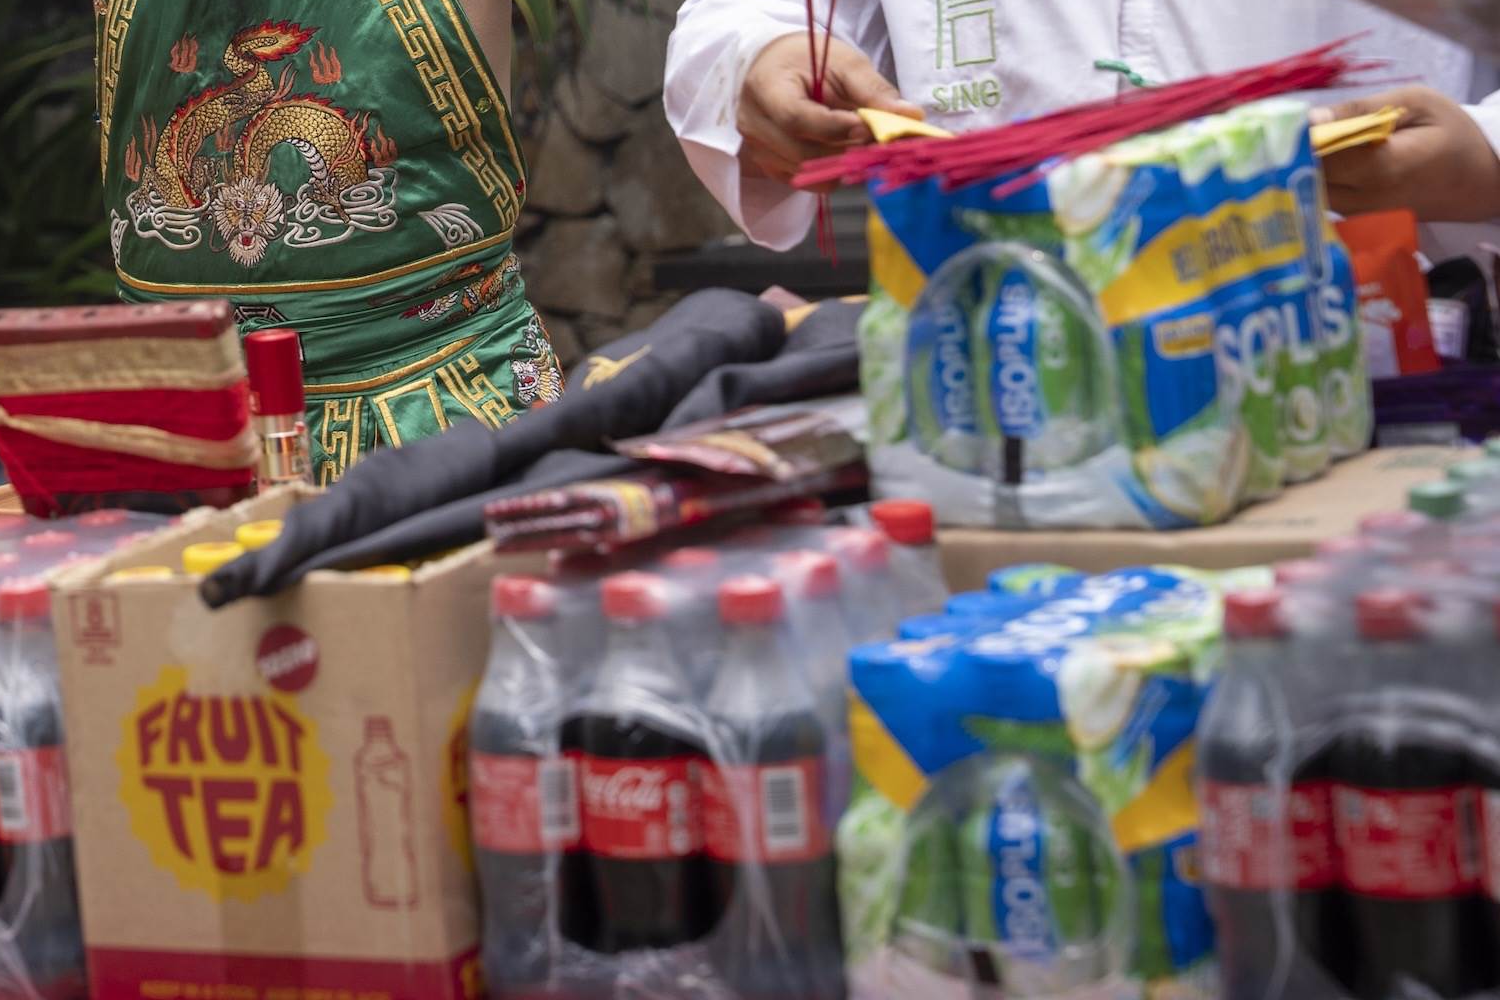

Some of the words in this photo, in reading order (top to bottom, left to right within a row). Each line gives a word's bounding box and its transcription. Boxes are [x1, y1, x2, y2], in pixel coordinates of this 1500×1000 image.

[932, 78, 1002, 114] SING
[137, 689, 306, 773] FRUIT
[143, 775, 306, 874] TEA
